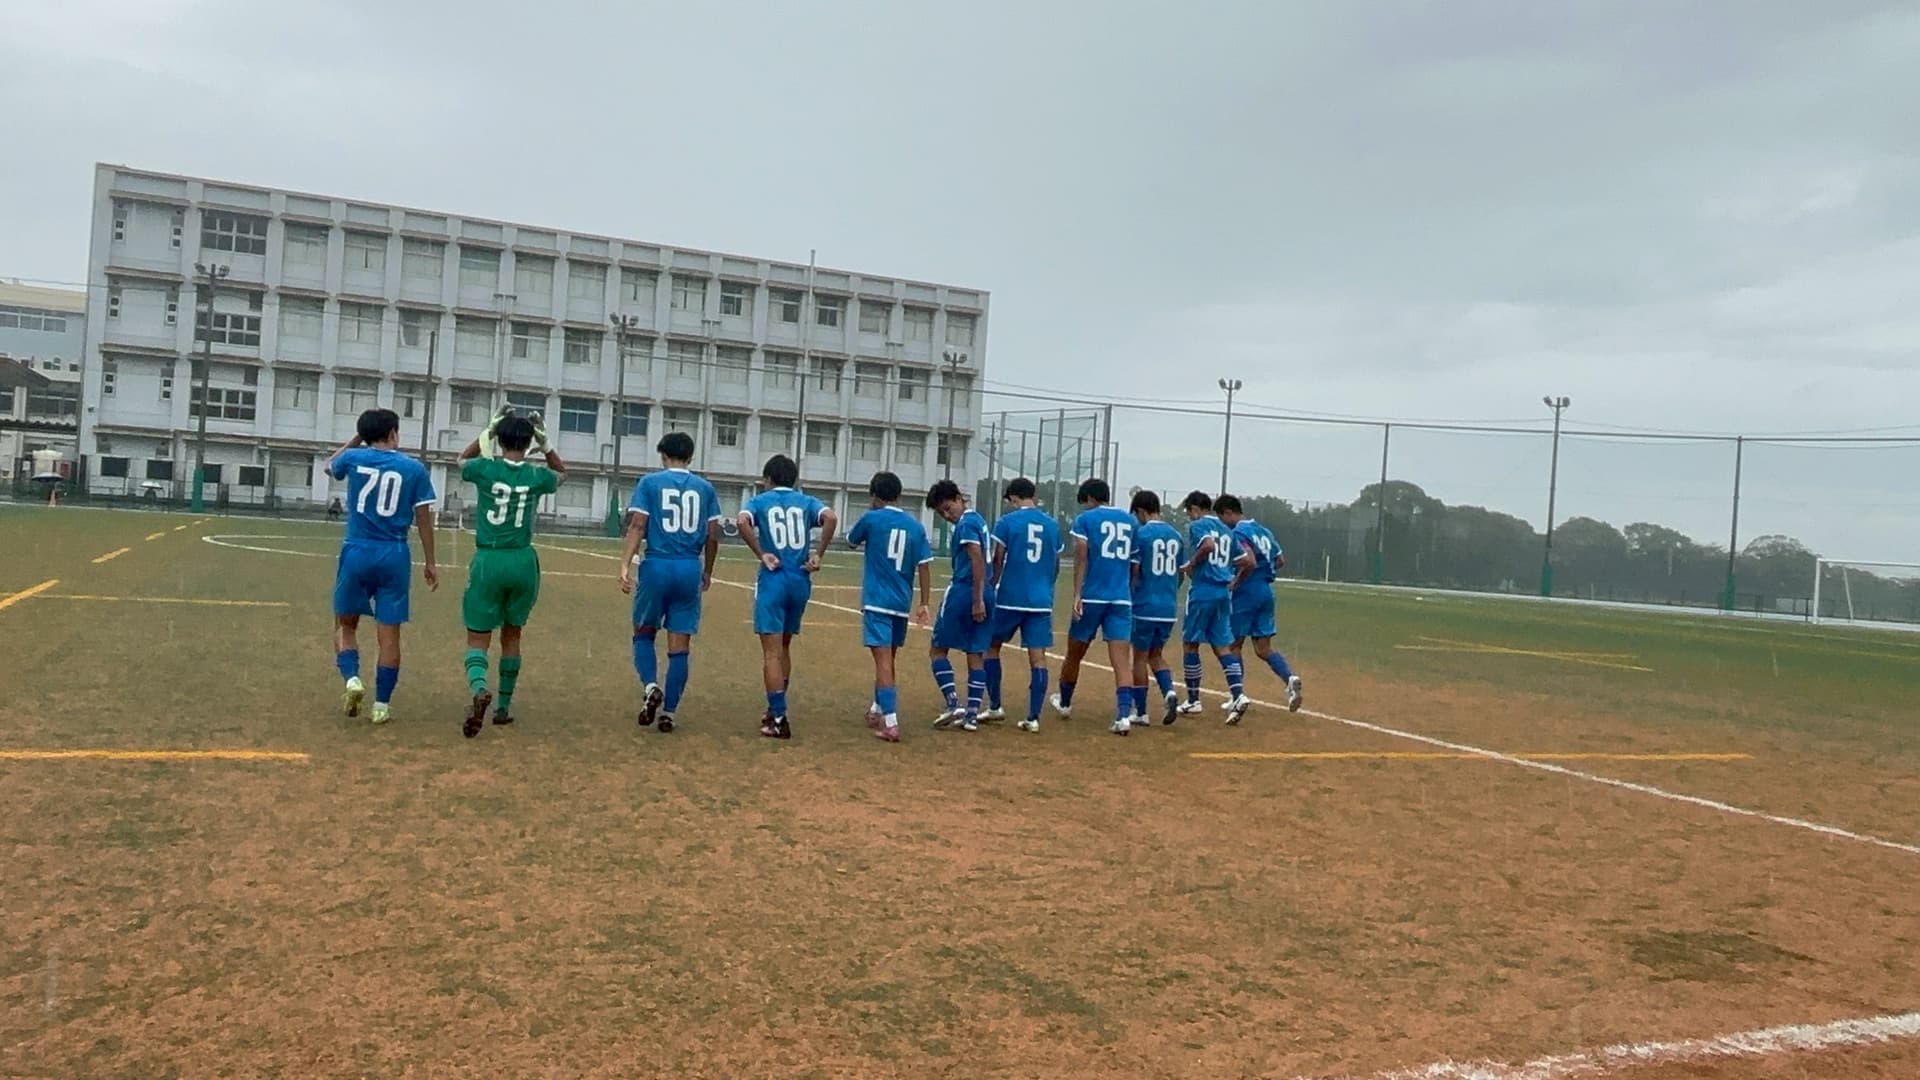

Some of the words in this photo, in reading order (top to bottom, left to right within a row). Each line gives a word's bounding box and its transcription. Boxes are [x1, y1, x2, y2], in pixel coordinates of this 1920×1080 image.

[356, 466, 402, 517] 70
[486, 482, 530, 528] 31
[661, 488, 701, 533] 50
[767, 506, 806, 550] 60
[887, 528, 907, 571] 4
[1026, 523, 1044, 563] 5
[1100, 520, 1132, 560] 25
[1151, 538, 1179, 576] 68
